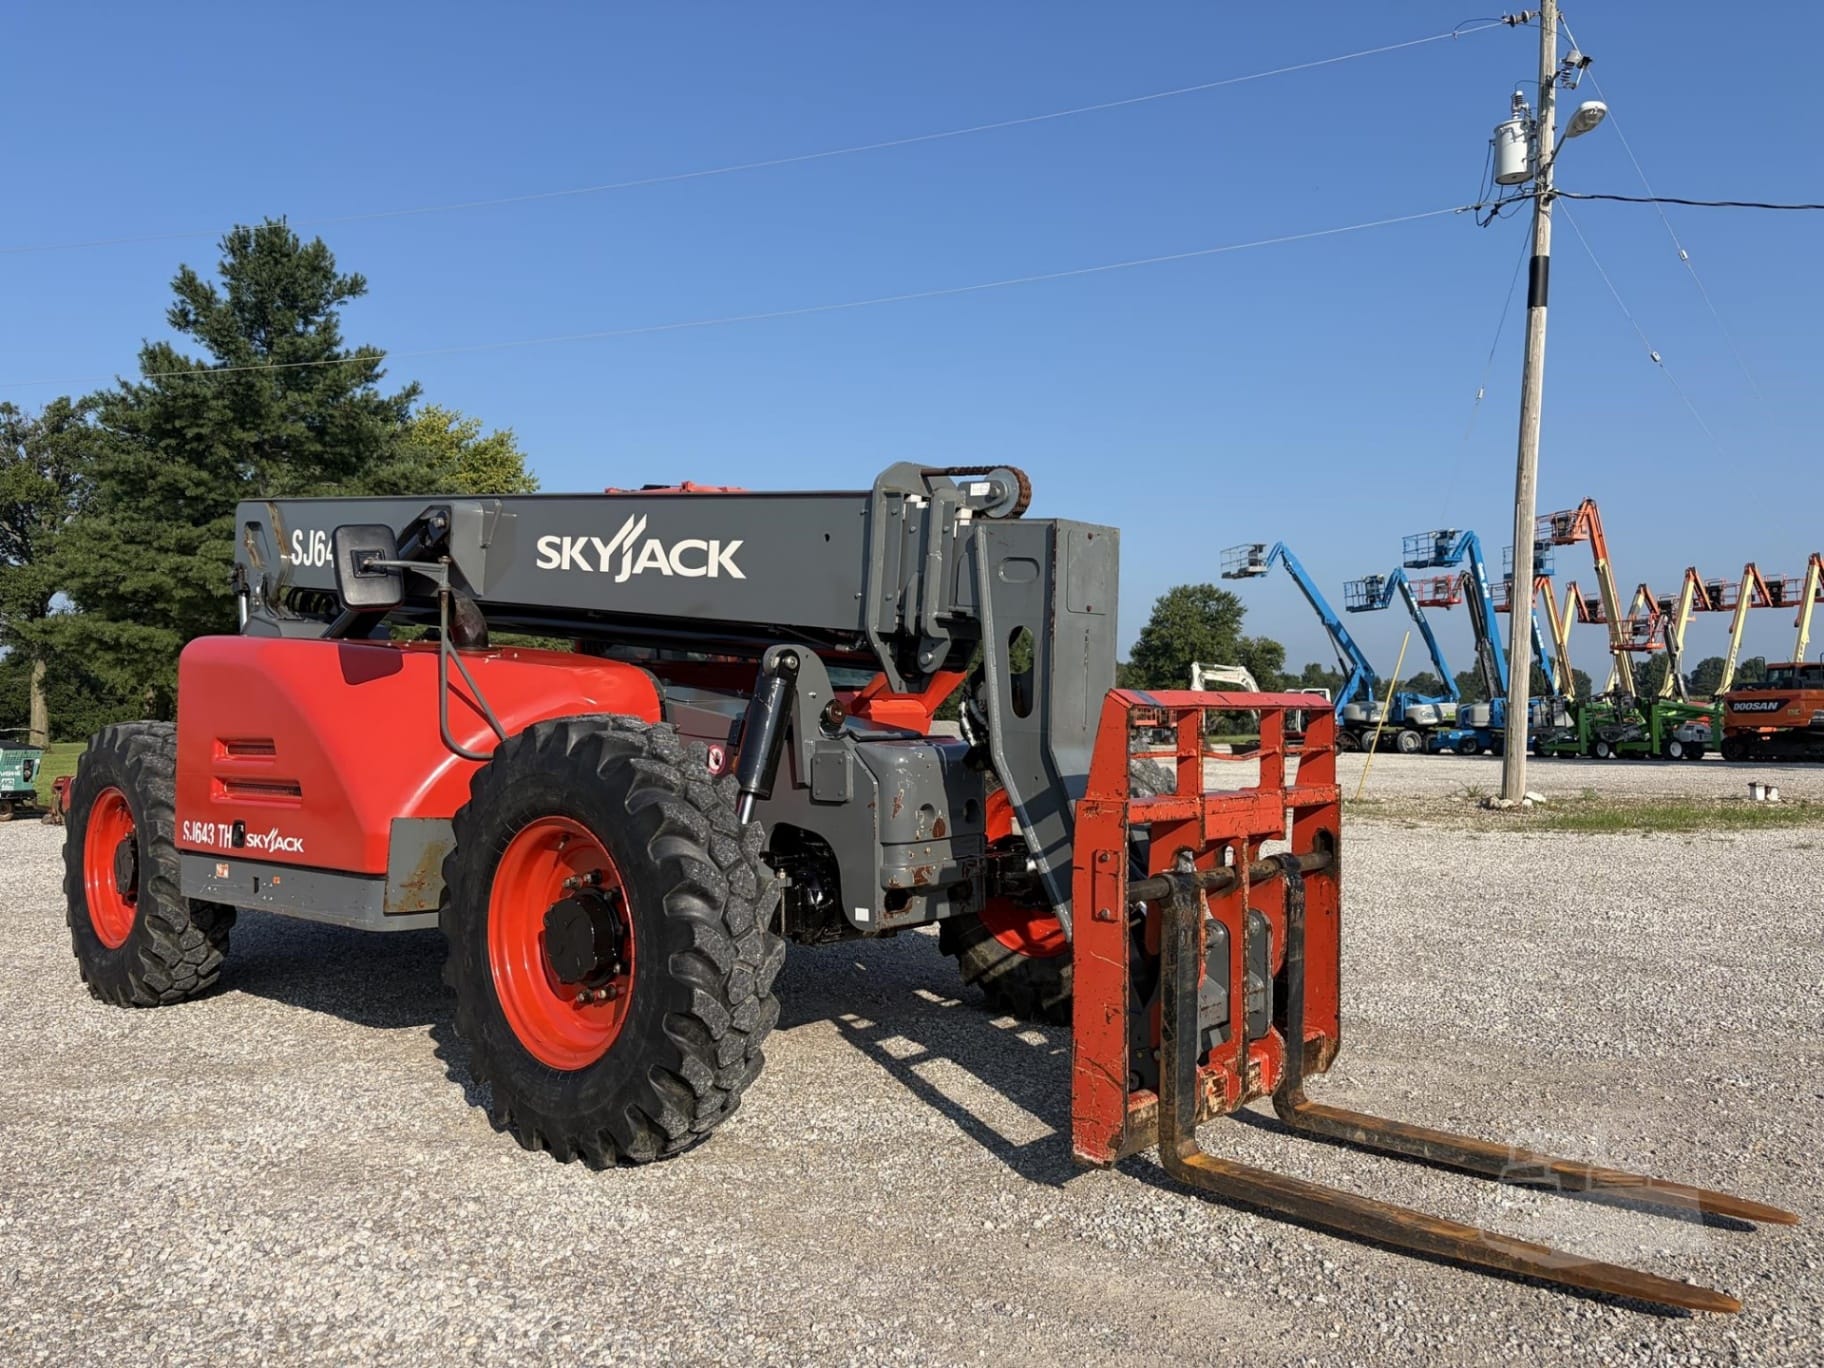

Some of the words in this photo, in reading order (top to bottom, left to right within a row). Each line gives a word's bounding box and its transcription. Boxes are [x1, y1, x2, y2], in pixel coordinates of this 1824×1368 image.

[536, 513, 747, 583] SKYJACK
[1733, 702, 1778, 711] DOOSAN
[183, 820, 215, 845] SJ643
[218, 824, 233, 848] TH
[246, 827, 304, 853] SKYJACK
